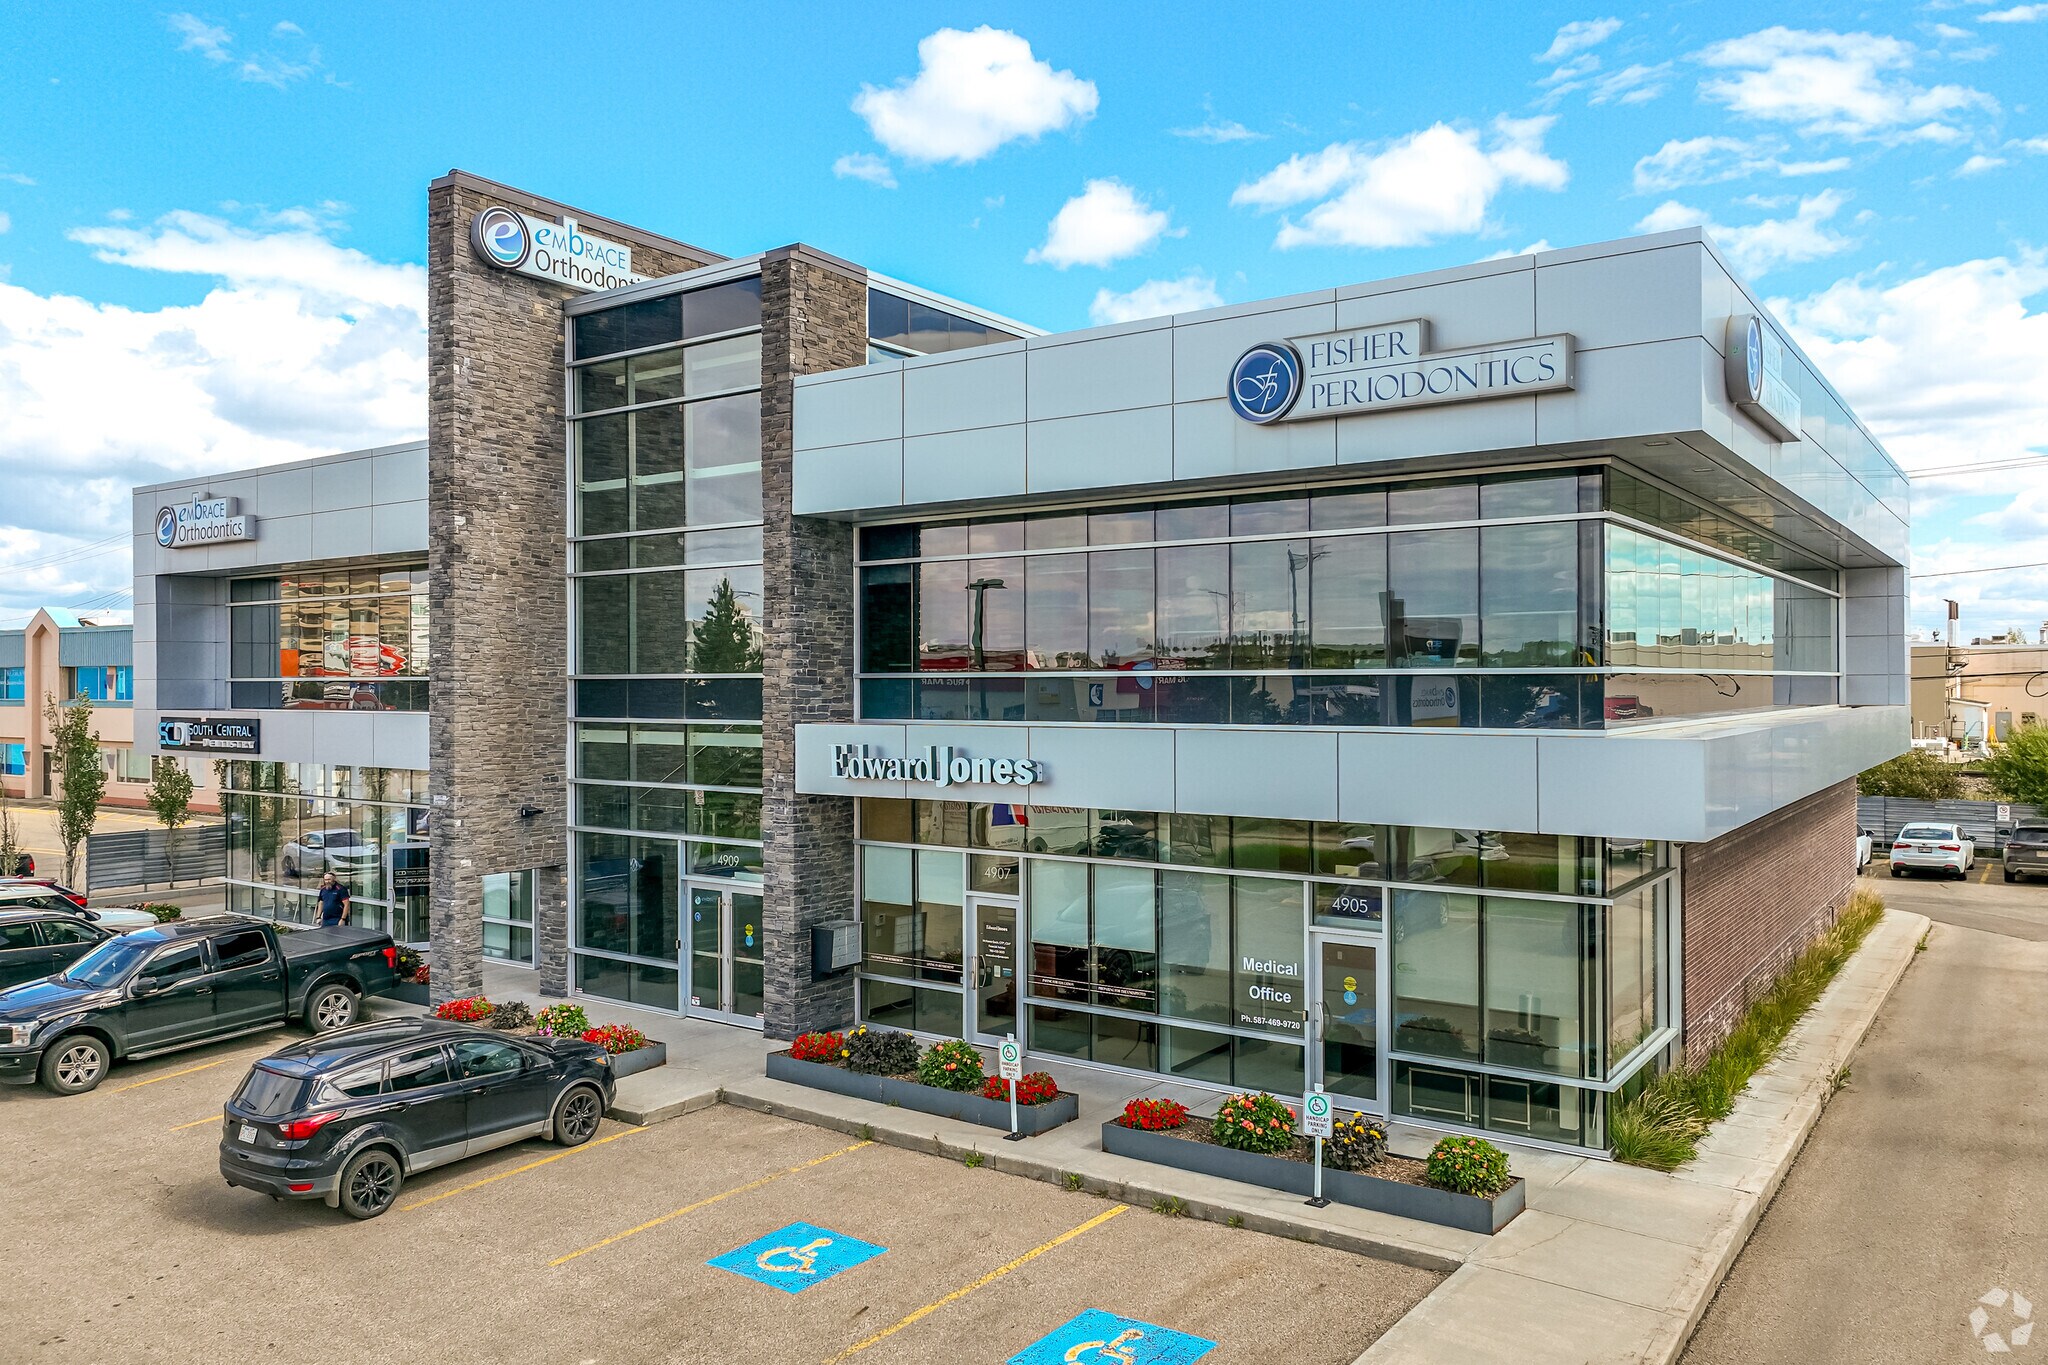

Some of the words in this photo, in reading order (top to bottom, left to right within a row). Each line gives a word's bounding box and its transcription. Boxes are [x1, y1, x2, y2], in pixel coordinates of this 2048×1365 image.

[1310, 331, 1412, 368] FISHER
[1311, 353, 1555, 409] PERIODONTICS
[178, 520, 243, 542] Orthodontics
[717, 854, 740, 867] 4909
[984, 866, 1011, 880] 4907
[1332, 897, 1368, 913] 4905
[1243, 957, 1298, 976] Medical
[1249, 985, 1292, 1003] Office
[1253, 1016, 1301, 1030] 587-469-9720
[1307, 1121, 1328, 1129] PARKING
